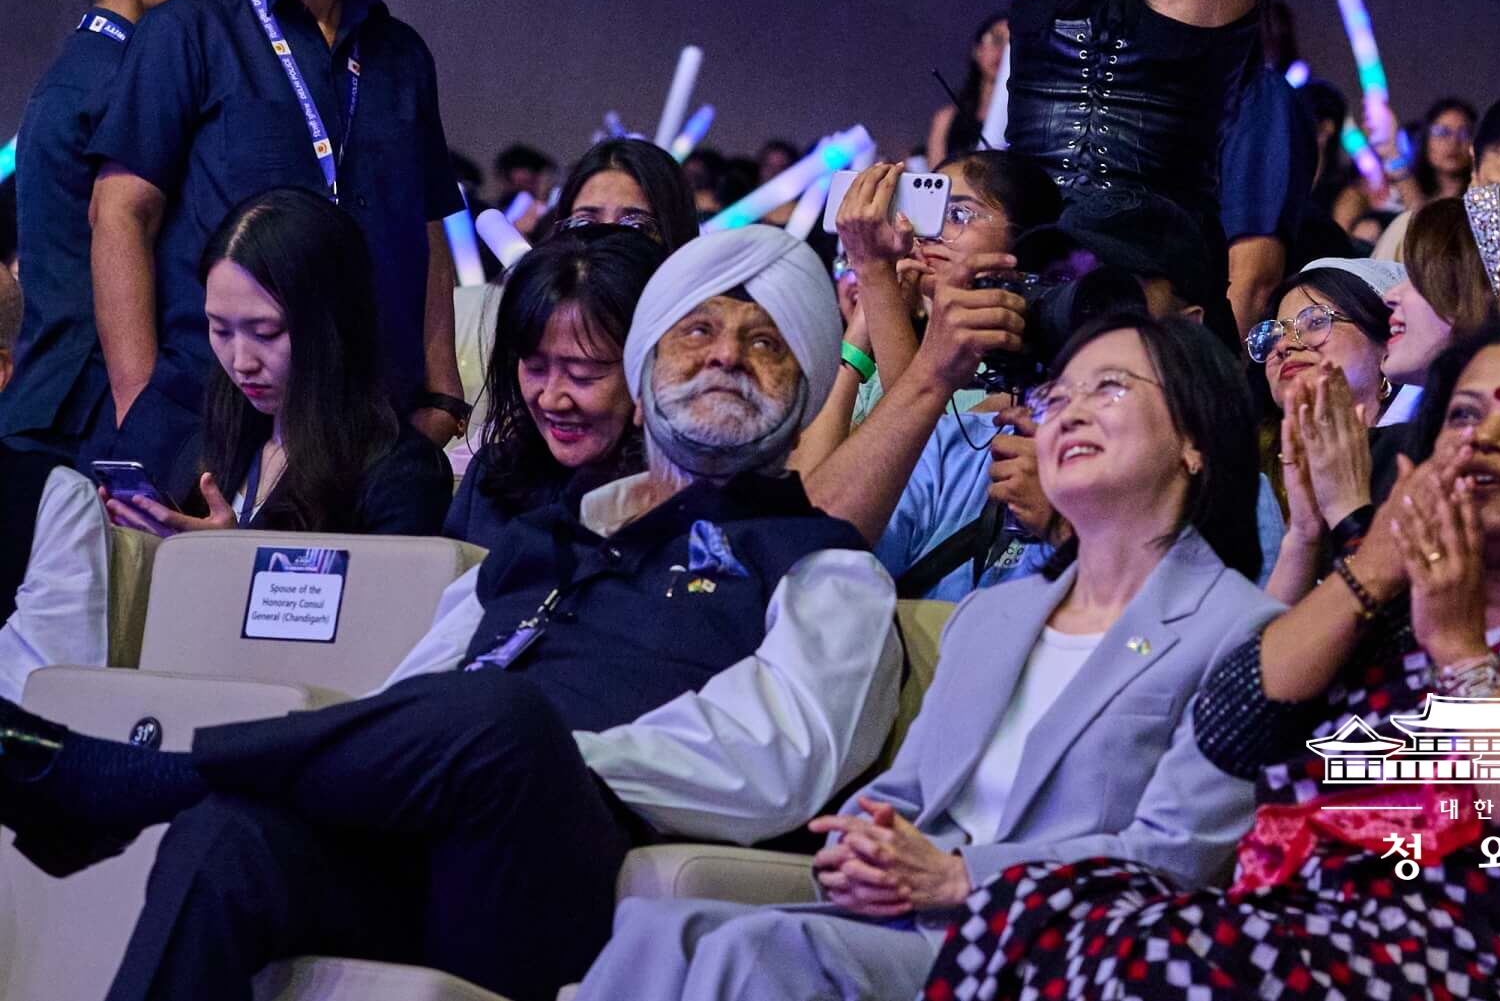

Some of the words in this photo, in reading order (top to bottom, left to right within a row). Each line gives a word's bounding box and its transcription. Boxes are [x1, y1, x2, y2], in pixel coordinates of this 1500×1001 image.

[269, 583, 297, 595] Spouse
[299, 584, 309, 594] of
[309, 584, 322, 595] the
[262, 597, 298, 611] Honorary
[299, 599, 326, 610] Consul
[251, 611, 281, 622] General
[282, 612, 331, 626] (Chandigarh)
